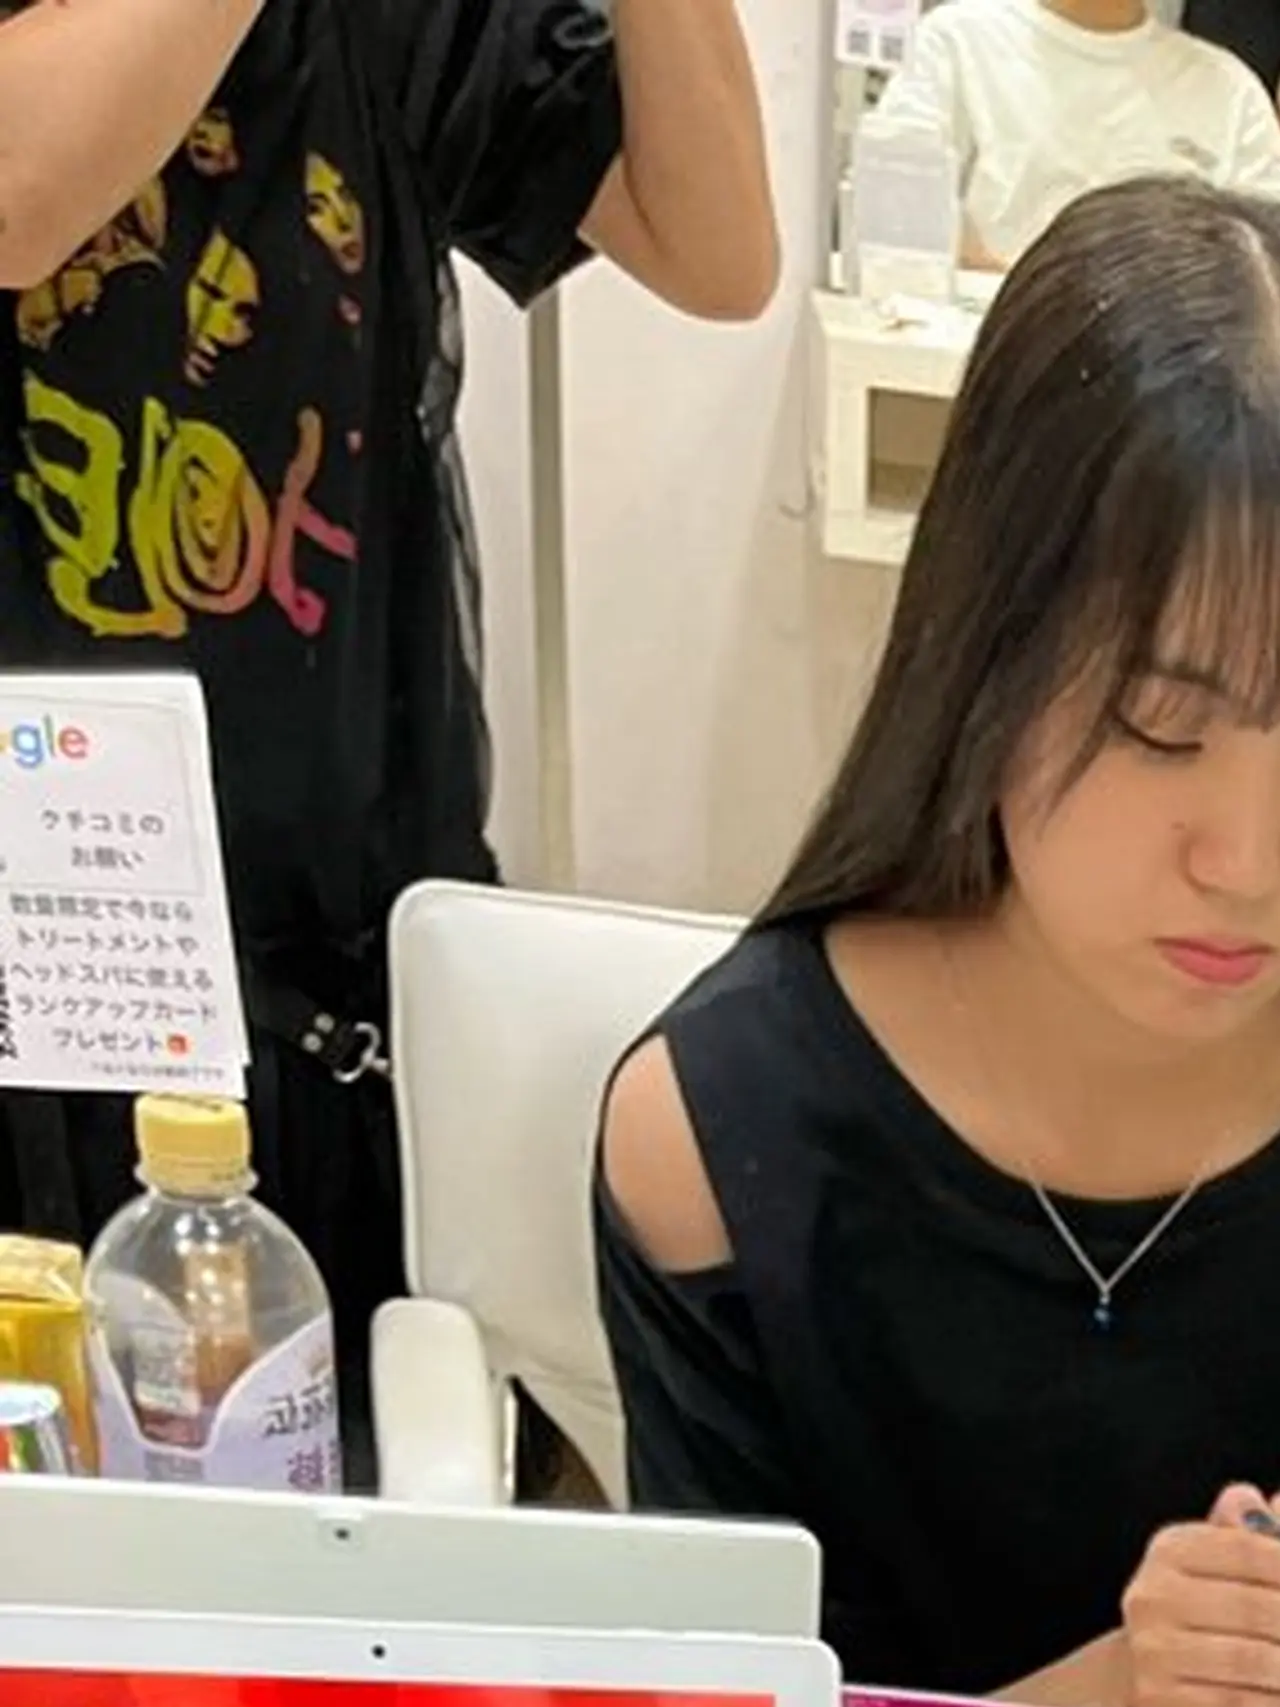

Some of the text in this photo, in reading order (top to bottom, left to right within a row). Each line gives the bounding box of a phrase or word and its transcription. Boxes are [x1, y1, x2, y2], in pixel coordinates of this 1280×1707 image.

[17, 927, 200, 957] トリートメントや
[10, 962, 214, 992] ヘッドスパに使える
[54, 1027, 162, 1053] プレゼント
